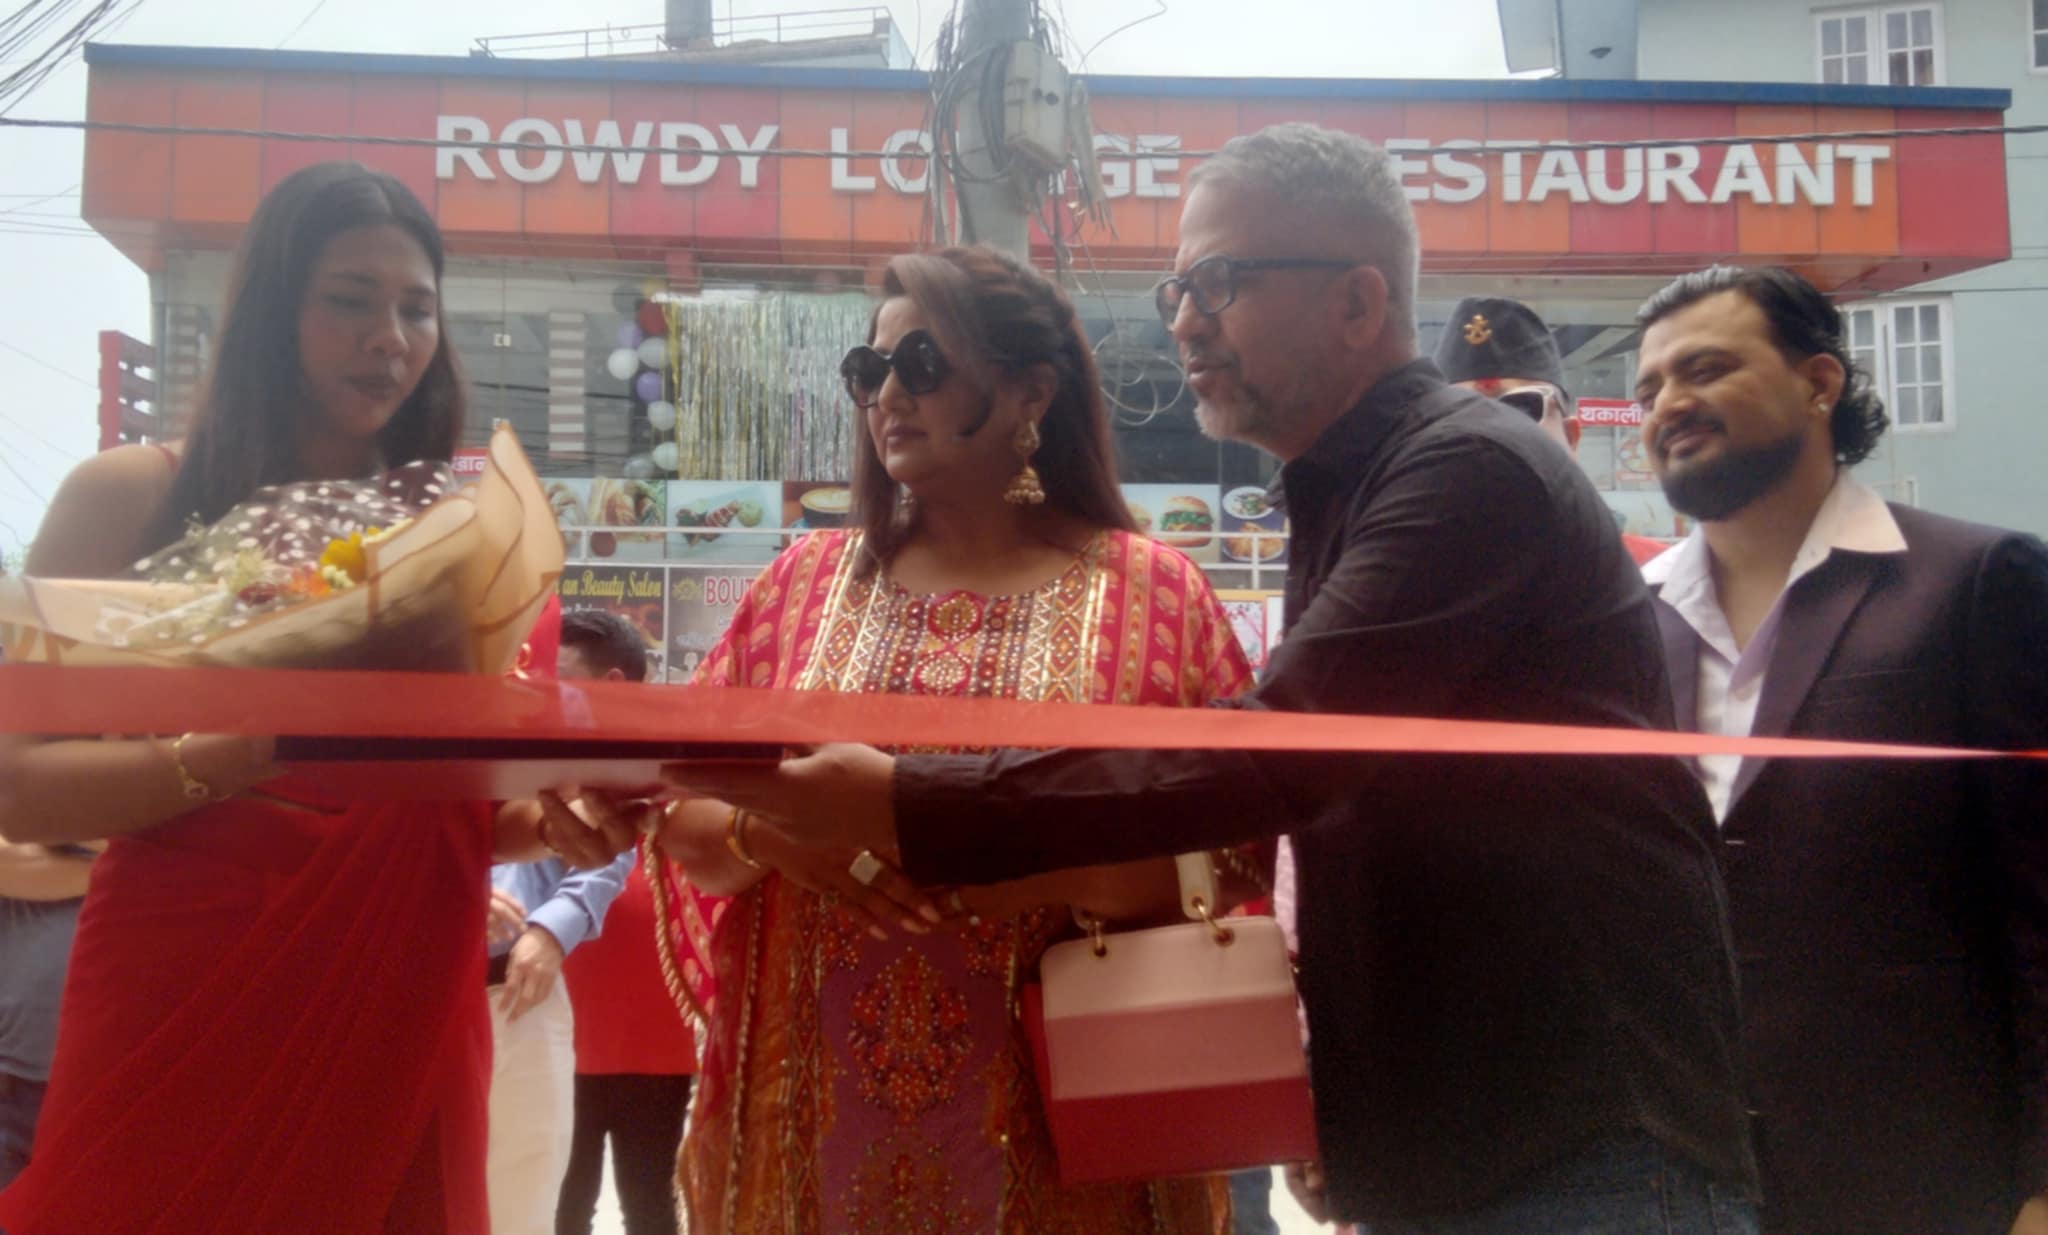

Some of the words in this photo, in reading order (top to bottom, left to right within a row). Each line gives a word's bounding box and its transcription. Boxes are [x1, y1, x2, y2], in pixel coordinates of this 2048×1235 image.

[435, 114, 780, 187] ROWDY
[831, 127, 1182, 198] LOGE
[1385, 138, 1891, 206] ESTAURANT
[580, 569, 624, 605] Beauty
[627, 570, 661, 597] Salon
